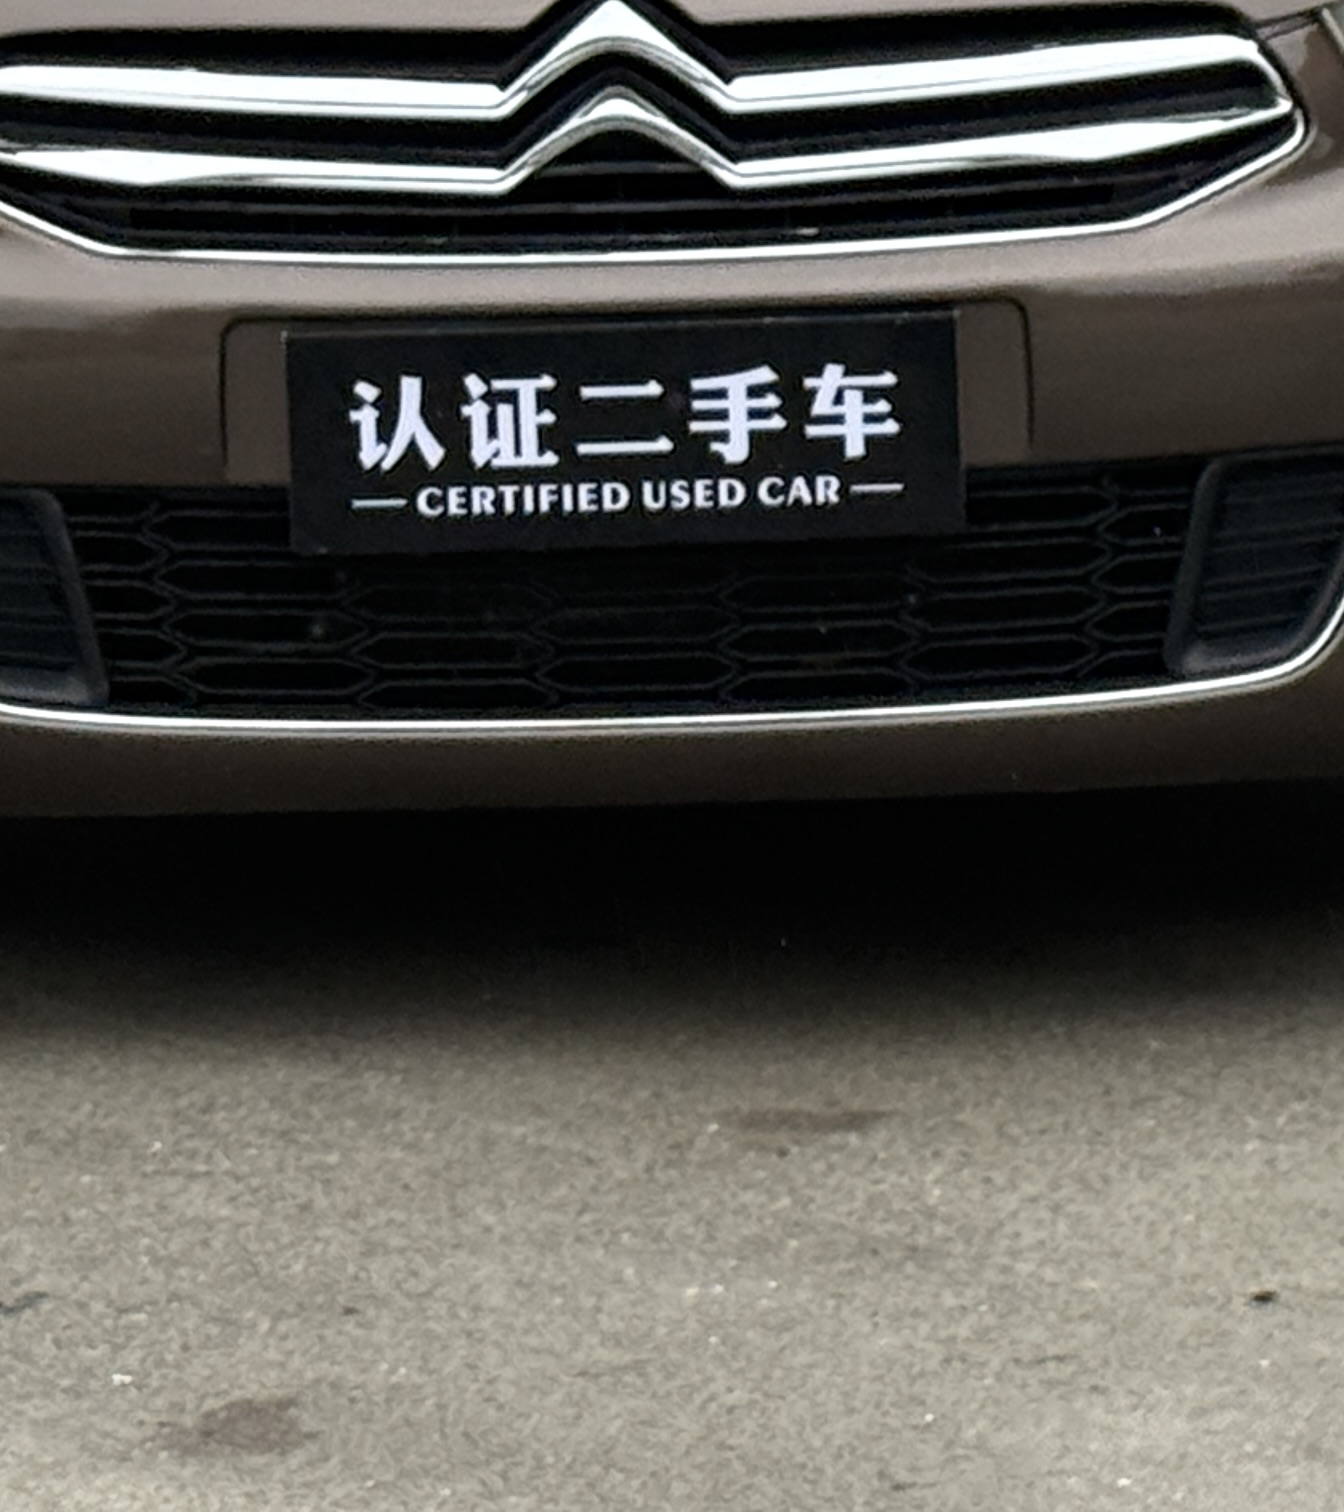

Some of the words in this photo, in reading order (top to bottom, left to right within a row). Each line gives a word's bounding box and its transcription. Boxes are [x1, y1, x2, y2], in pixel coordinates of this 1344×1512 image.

[349, 363, 900, 471] 认证二手车
[416, 482, 630, 517] CERTIFIED
[642, 478, 746, 511] USED
[757, 475, 841, 506] CAR
